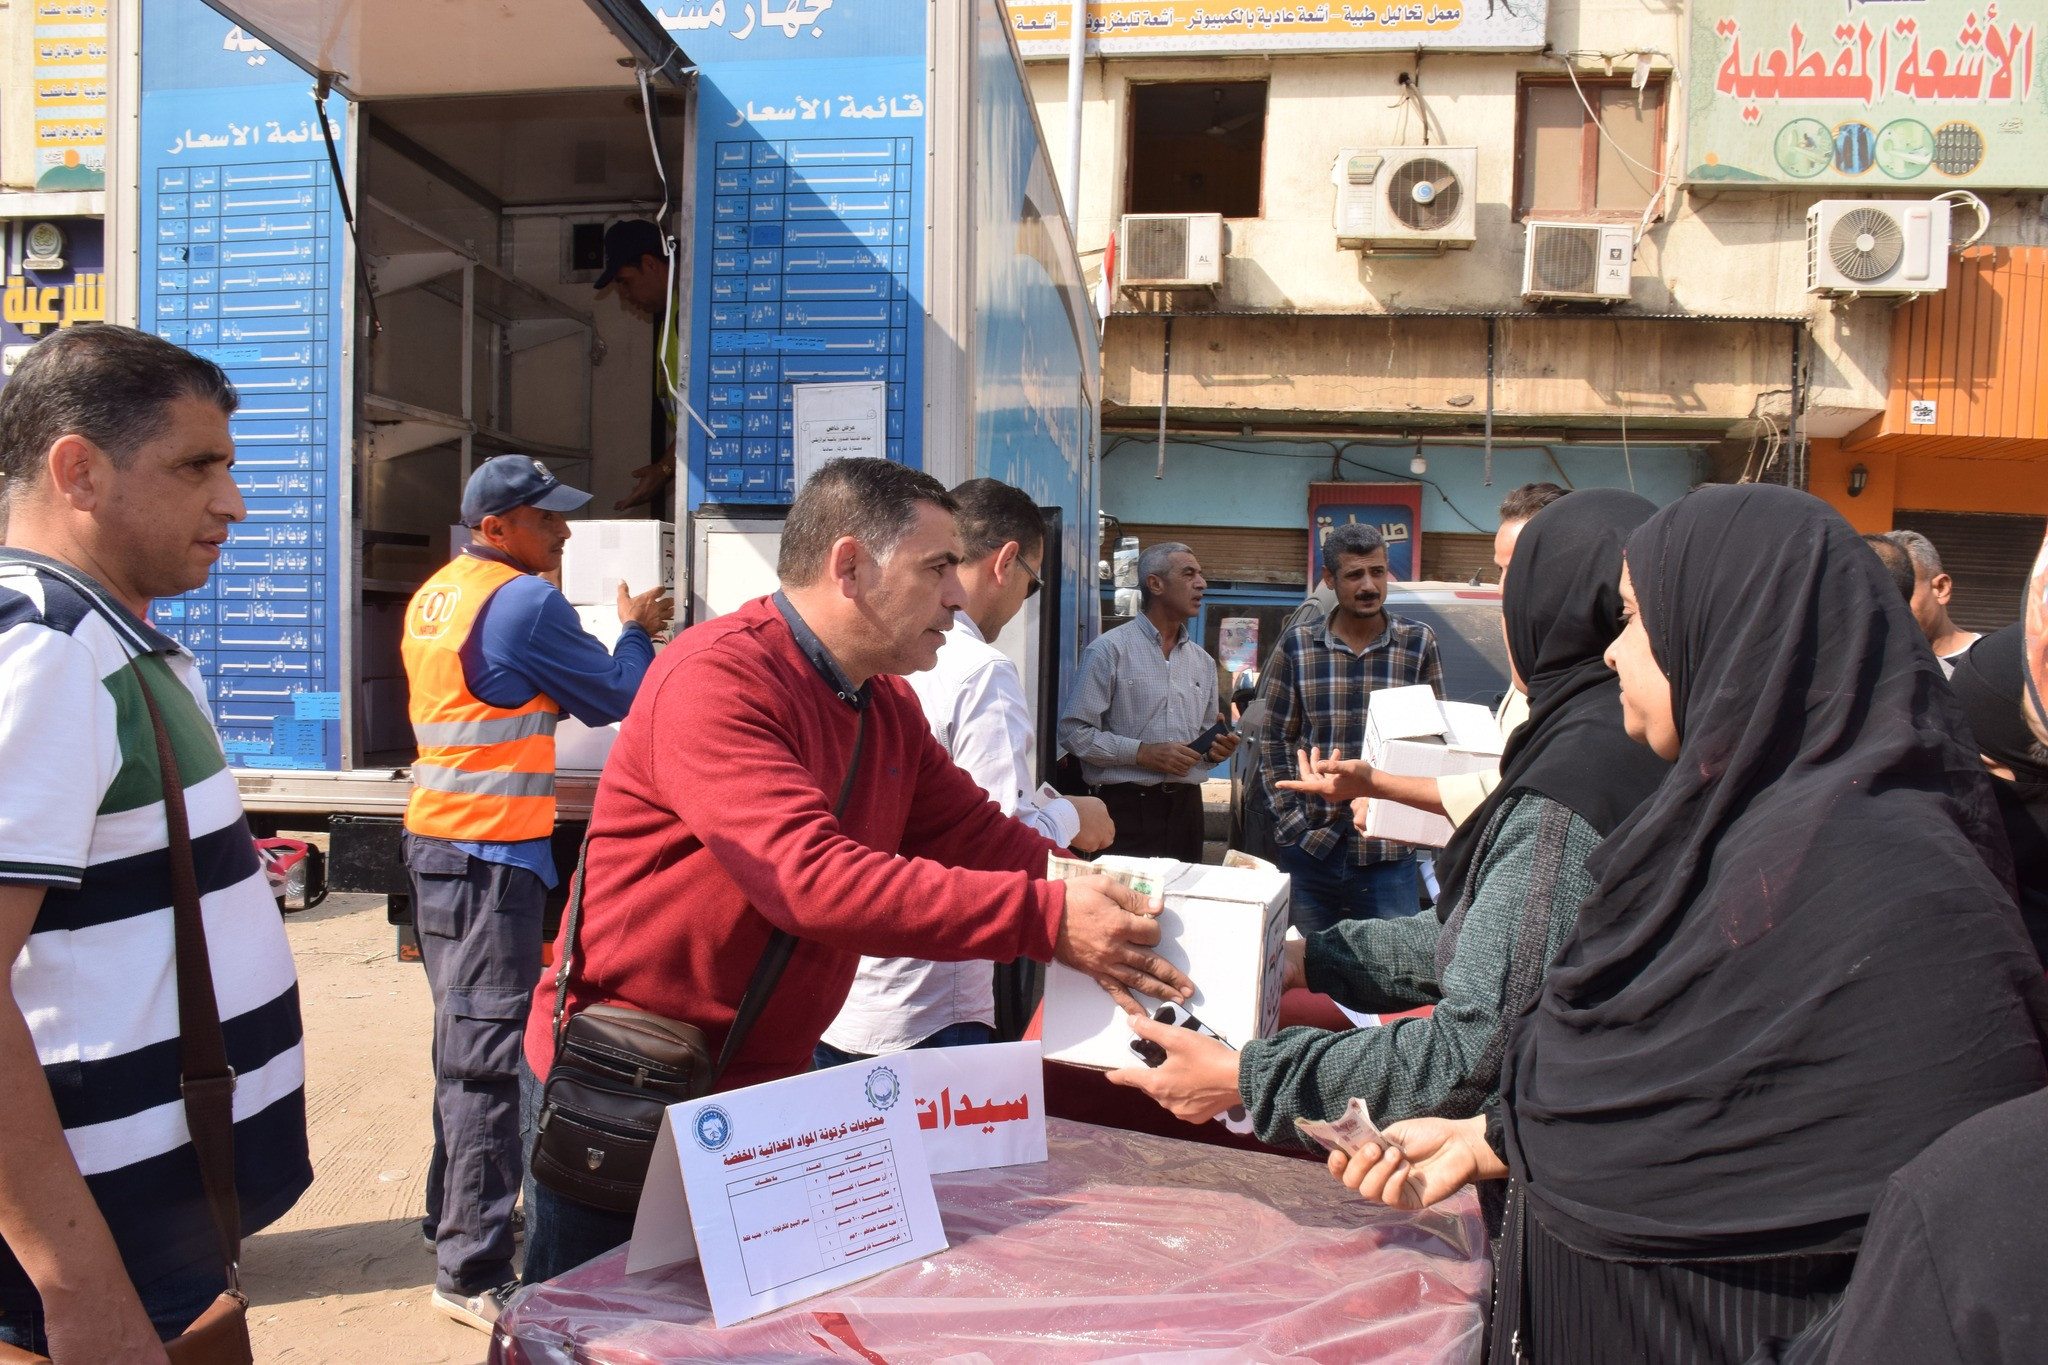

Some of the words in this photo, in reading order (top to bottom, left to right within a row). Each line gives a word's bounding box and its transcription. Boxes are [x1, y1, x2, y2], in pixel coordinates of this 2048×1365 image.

[1143, 10, 1174, 29] أشعة
[1187, 9, 1254, 32] بالكمبيوتر
[1256, 8, 1294, 29] عادية
[1298, 7, 1329, 26] أشعة
[1343, 6, 1376, 26] طبية
[1379, 6, 1422, 27] تحاليل
[1426, 8, 1461, 24] معمل
[1893, 3, 2035, 100] الأشعة
[1716, 17, 1888, 122] المقطعية
[726, 95, 830, 128] الأسعار
[839, 93, 924, 118] قائمة
[166, 122, 260, 154] الأسعار
[914, 1086, 1029, 1134] سيدات
[819, 1122, 848, 1141] كرتونة
[849, 1115, 885, 1133] محتويات
[758, 1137, 795, 1159] الغذائية
[796, 1130, 817, 1148] المواد
